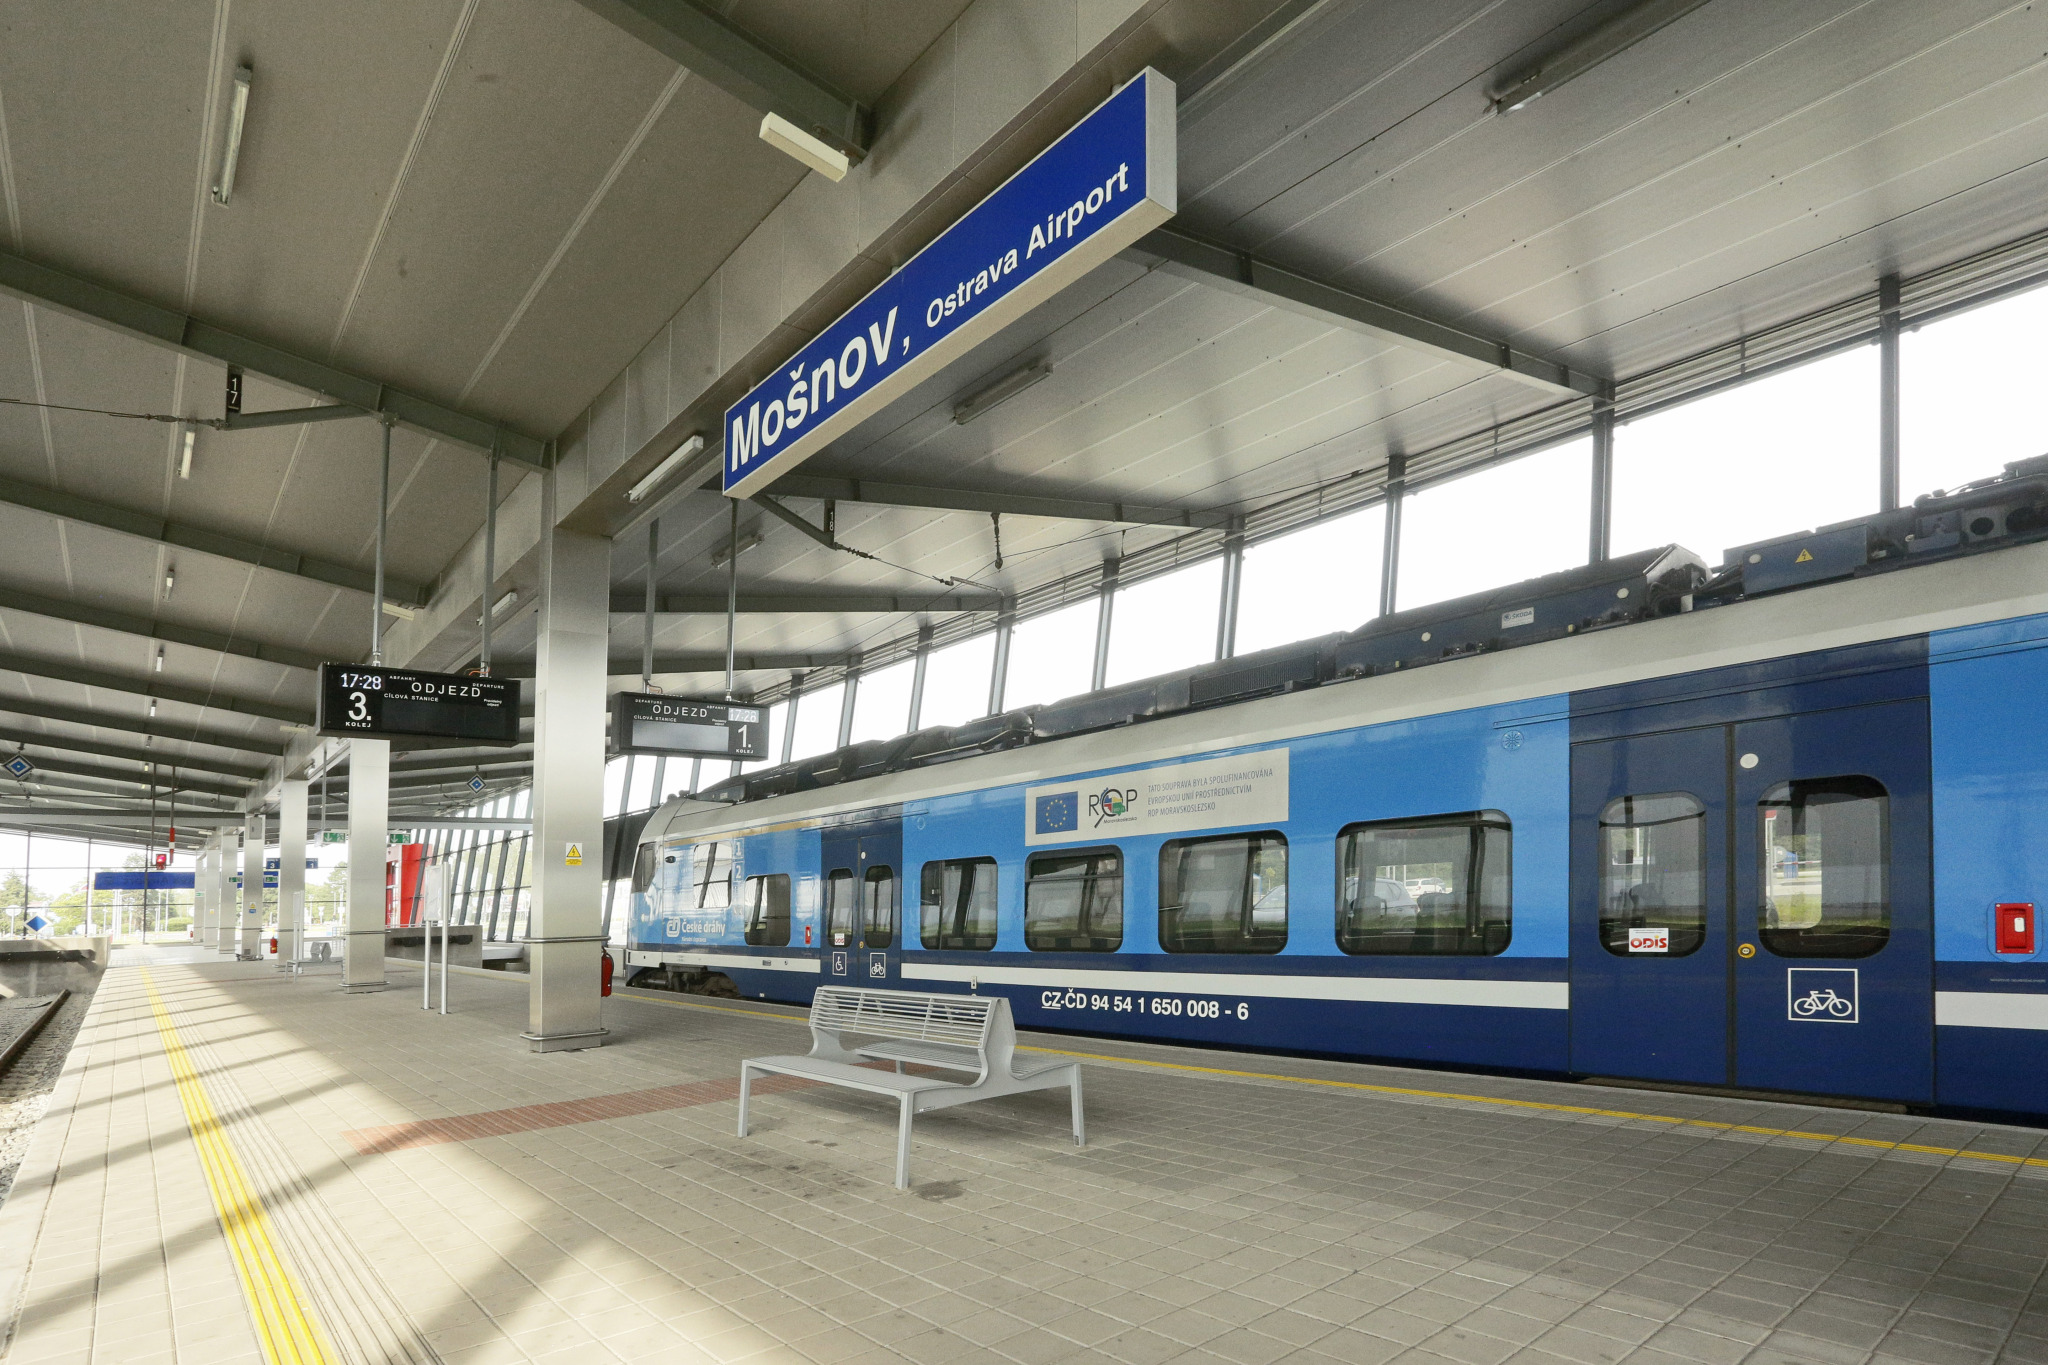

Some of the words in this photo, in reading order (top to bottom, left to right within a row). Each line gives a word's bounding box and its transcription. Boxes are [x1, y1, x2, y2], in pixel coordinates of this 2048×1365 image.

[731, 305, 910, 473] Mošnov,
[926, 248, 1018, 328] Ostrava
[1026, 162, 1129, 260] Airport
[340, 673, 382, 690] 17:28
[472, 682, 505, 690] DEPARTURE
[383, 692, 409, 700] CÍLOVÁ
[411, 682, 481, 698] ODJEZD
[348, 691, 372, 721] 3.
[652, 704, 708, 718] ODJEZD
[730, 708, 757, 723] 17:28
[737, 724, 752, 748] 1.
[1148, 784, 1161, 793] TATO
[1162, 779, 1191, 791] SOUPRAVA
[1192, 777, 1208, 788] BYLA
[1147, 793, 1180, 806] EVROPSKOU
[1147, 808, 1159, 817] ROP
[1160, 801, 1216, 816] MORAVSKOSLEZSKO
[681, 919, 702, 933] České
[703, 919, 726, 937] dráhy
[1091, 994, 1110, 1011] 94
[1113, 996, 1132, 1013] 54
[1137, 997, 1145, 1013] 1
[1151, 998, 1182, 1016] 650
[1187, 999, 1219, 1018] 008
[1236, 1002, 1249, 1021] 6
